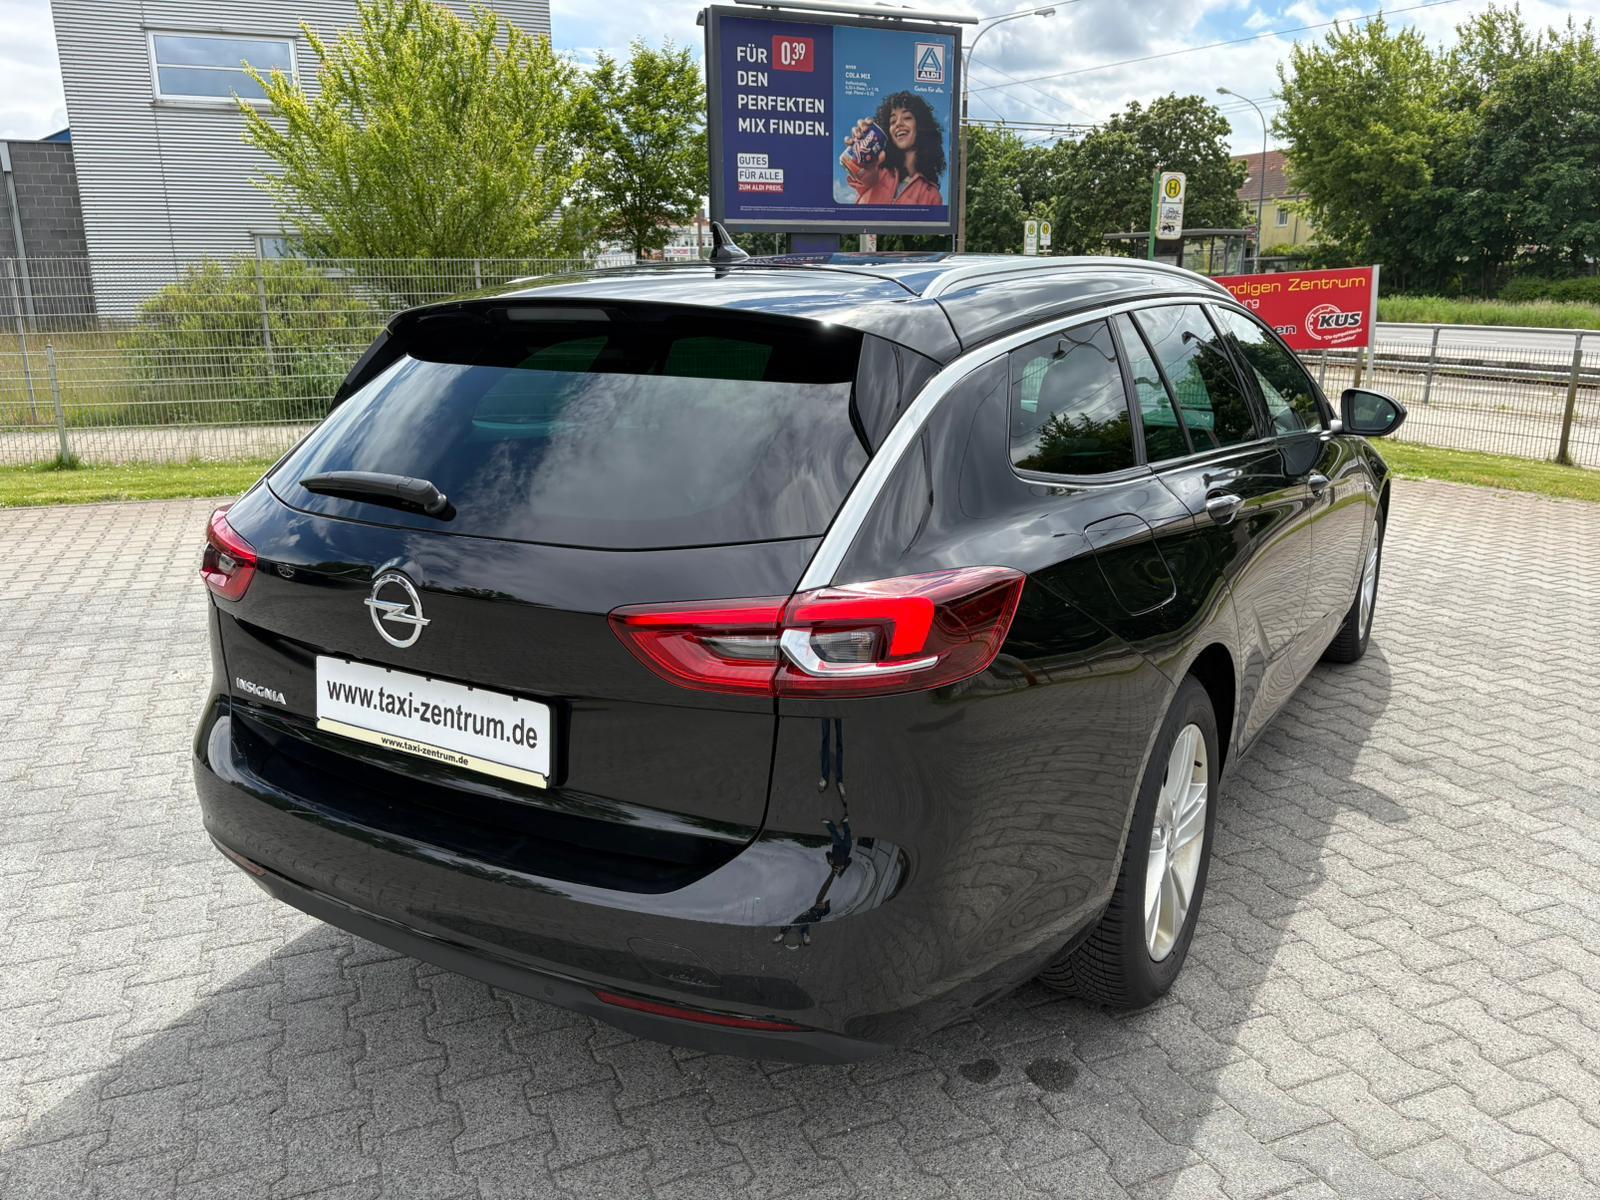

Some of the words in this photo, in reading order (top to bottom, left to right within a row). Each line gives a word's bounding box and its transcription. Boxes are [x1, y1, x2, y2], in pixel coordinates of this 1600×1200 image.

[737, 43, 768, 64] FÜR
[781, 41, 806, 65] 0.39
[737, 70, 768, 87] DEN
[920, 71, 939, 79] ALDI
[738, 94, 825, 114] PERFEKTEN
[738, 117, 766, 134] MIX
[769, 118, 829, 136] FINDEN.
[739, 156, 767, 166] GUTES
[739, 169, 757, 180] FÜR
[759, 171, 782, 180] ALLE.
[1222, 281, 1281, 296] ndigen
[1288, 276, 1366, 291] Zentrum
[1274, 324, 1297, 335] en
[1318, 311, 1362, 329] KÜS
[236, 677, 287, 705] INSIGNIA
[327, 680, 538, 748] www.taxi-zentrum.de
[381, 736, 469, 765] www.taxi-zentrum.de
